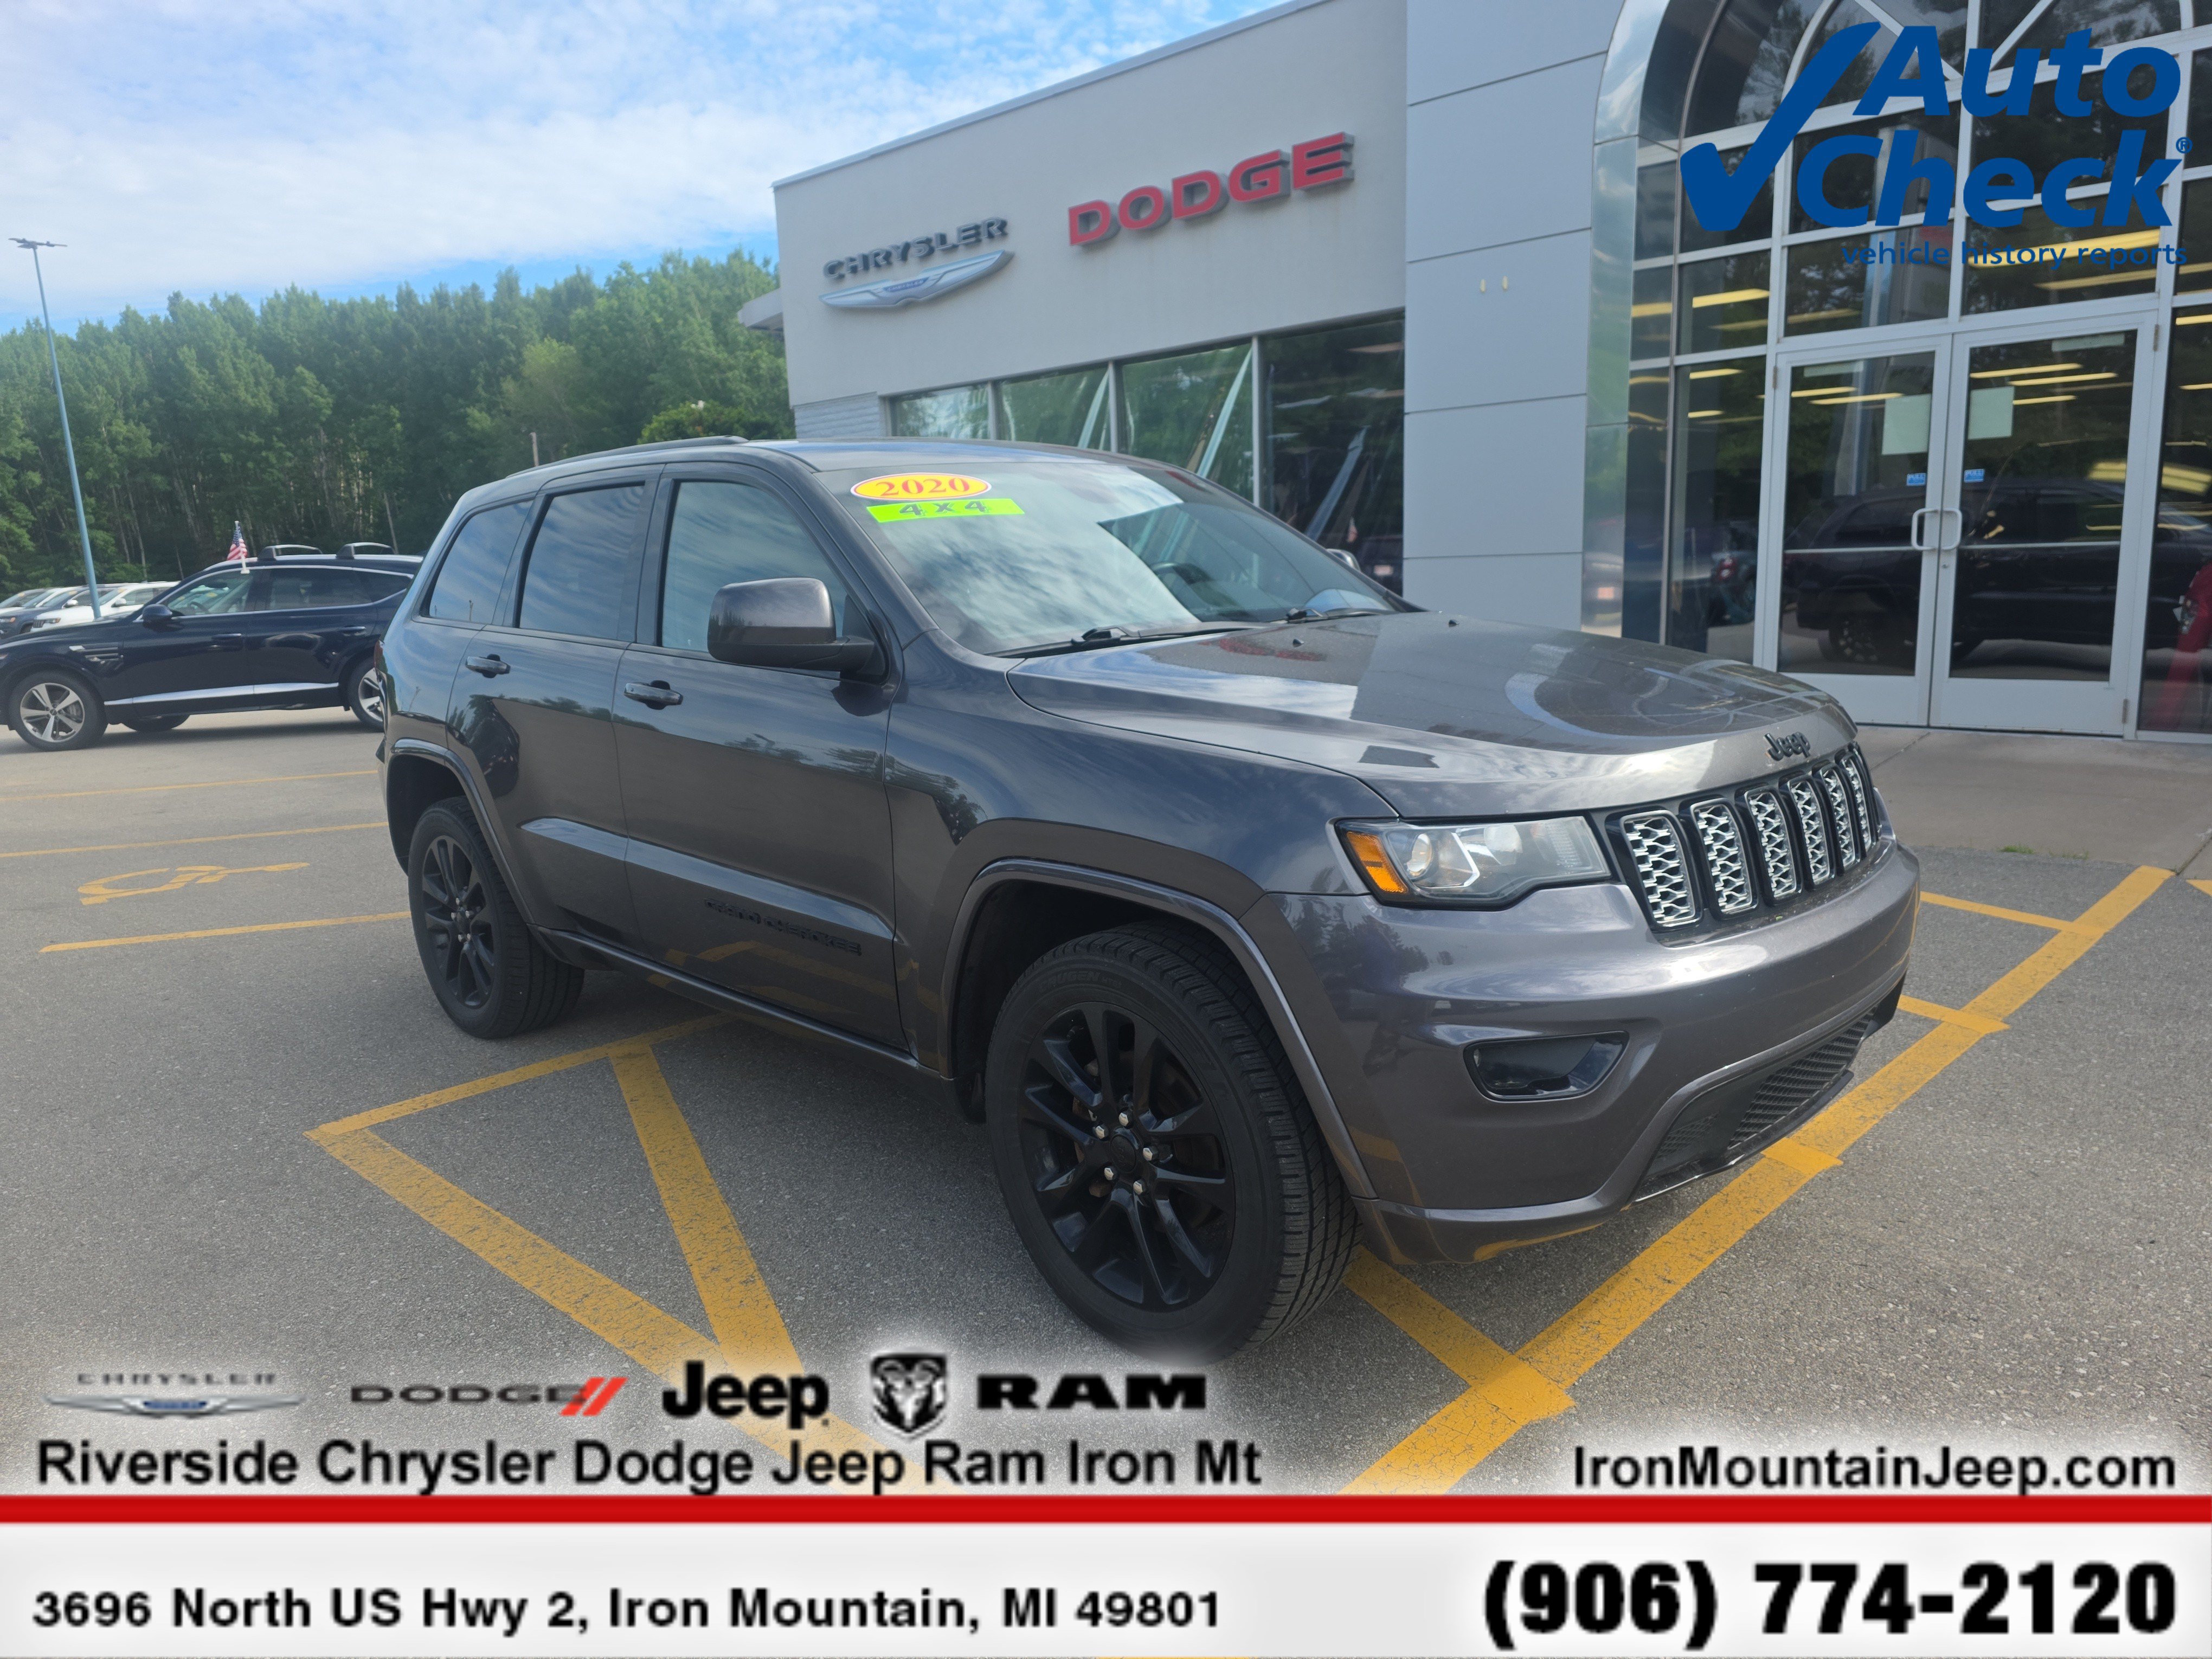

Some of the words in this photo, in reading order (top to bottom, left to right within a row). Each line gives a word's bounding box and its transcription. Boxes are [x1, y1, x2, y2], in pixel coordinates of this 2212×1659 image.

[1068, 132, 1354, 247] DODGE
[823, 217, 1009, 280] CHRYSLER
[876, 478, 969, 497] 2020
[1764, 731, 1811, 762] Jeep
